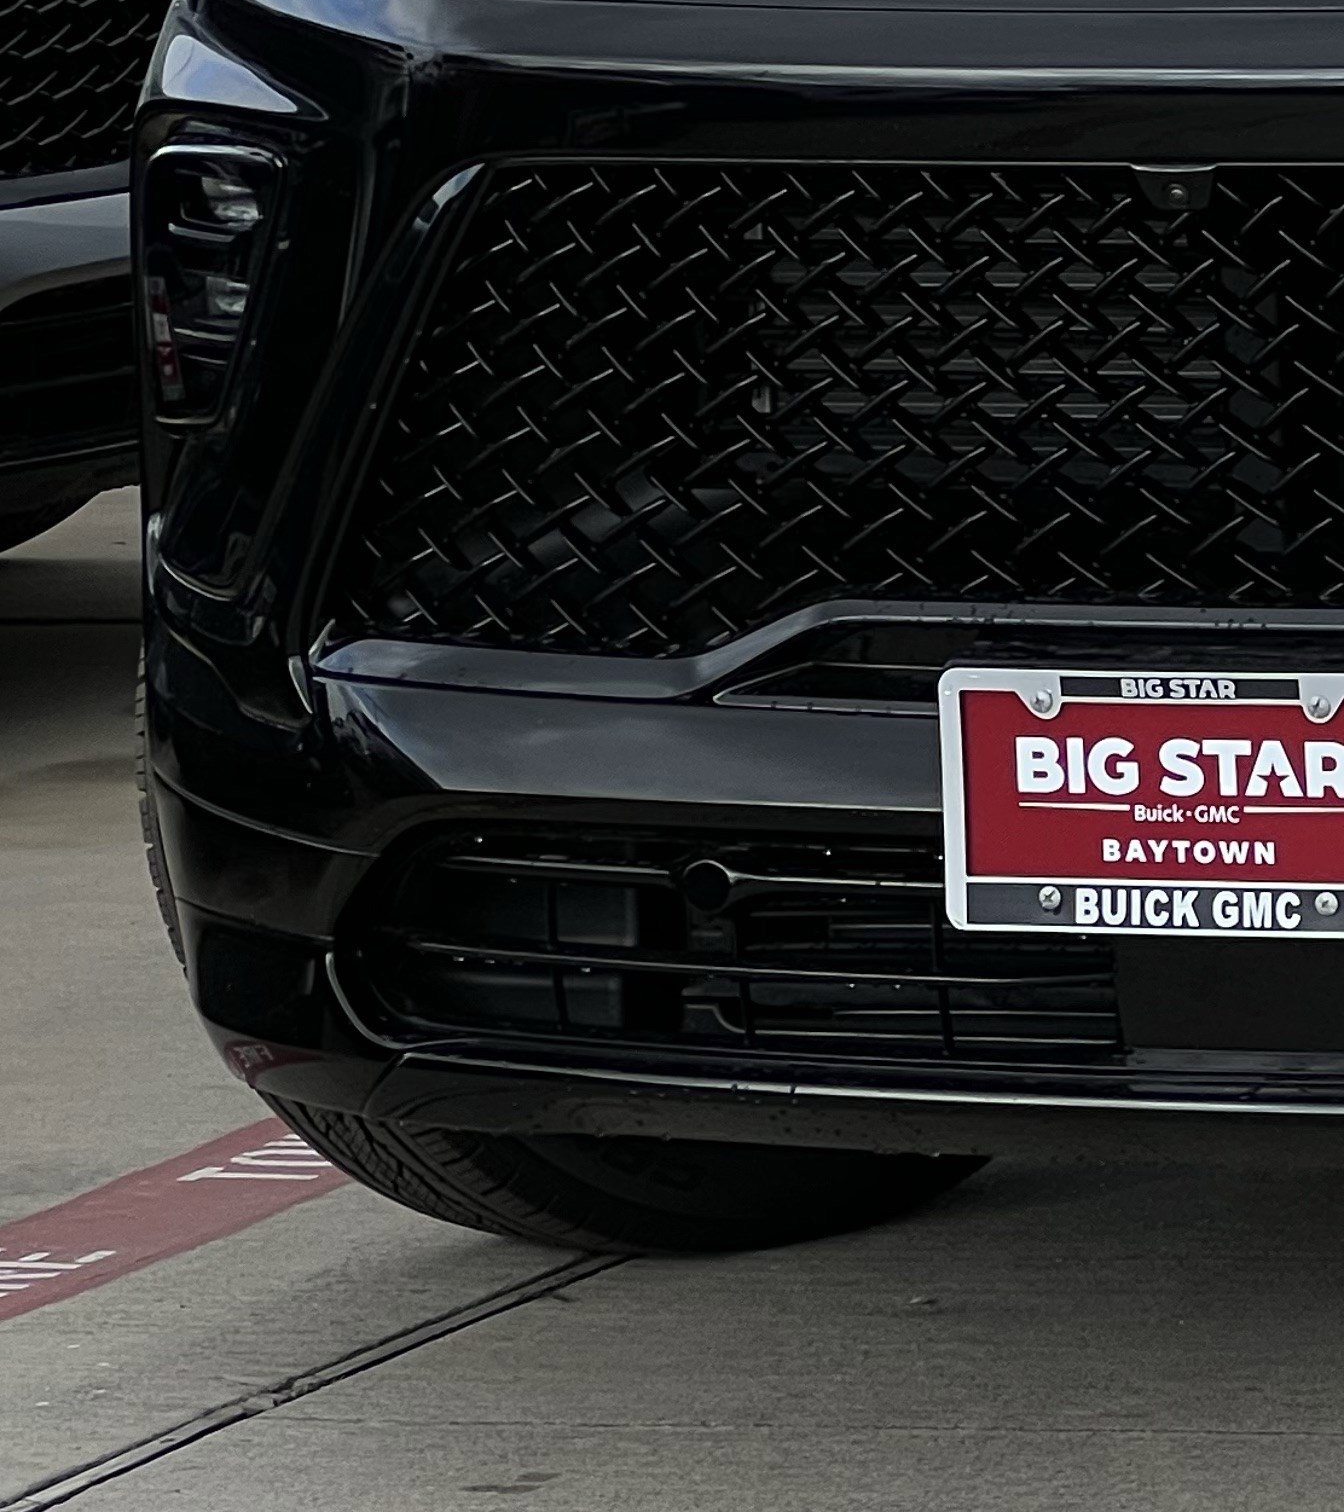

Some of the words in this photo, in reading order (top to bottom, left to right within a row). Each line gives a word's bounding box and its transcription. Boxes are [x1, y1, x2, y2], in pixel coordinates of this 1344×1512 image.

[1120, 678, 1167, 698] BIG
[1169, 679, 1236, 699] STAR
[1015, 736, 1139, 794] BIG
[1134, 804, 1184, 823] Buick
[1194, 805, 1240, 824] GMC
[1102, 839, 1276, 865] BAYTOWN
[1075, 888, 1200, 927] BUICK
[1212, 891, 1301, 929] GMC
